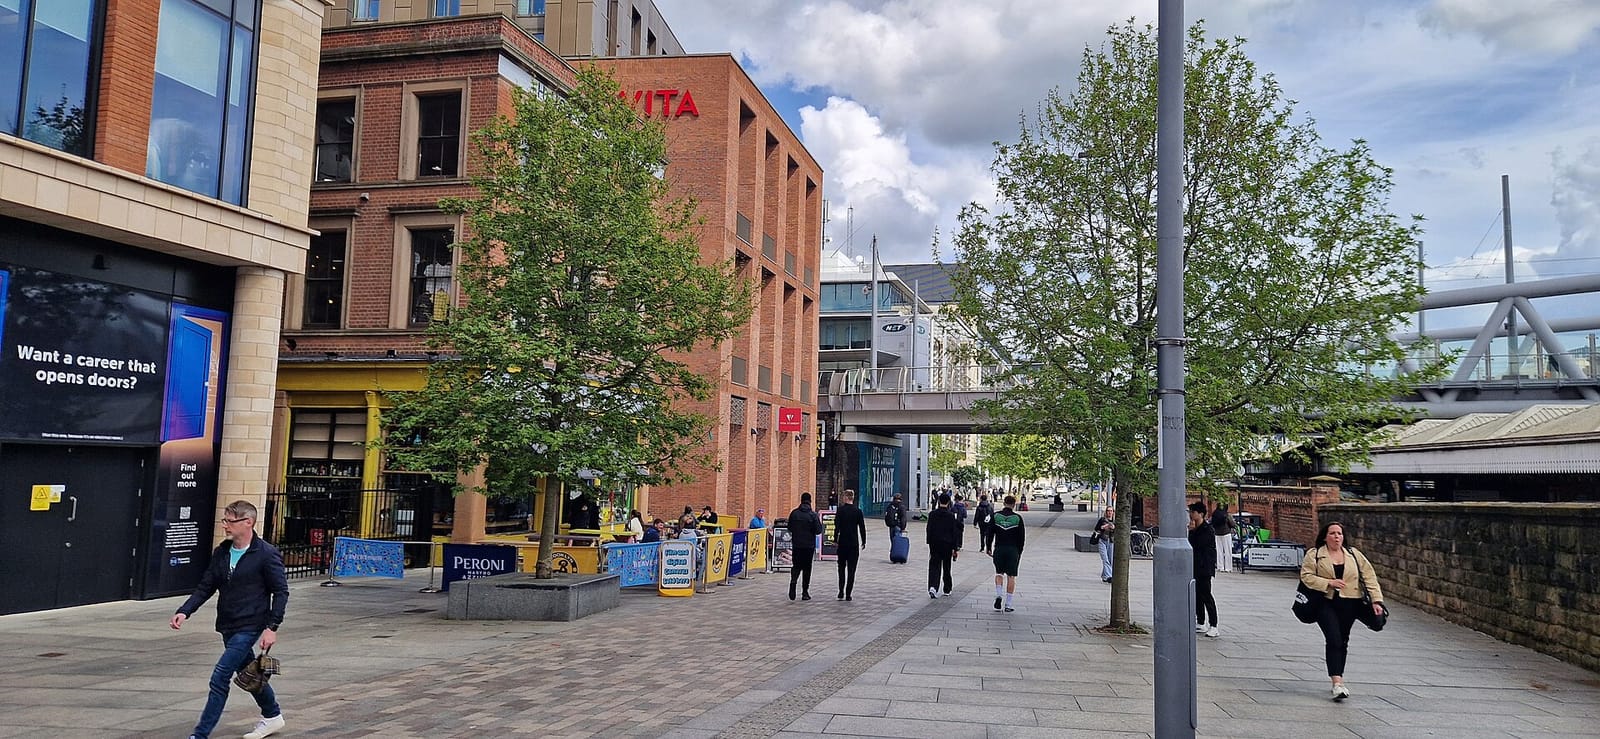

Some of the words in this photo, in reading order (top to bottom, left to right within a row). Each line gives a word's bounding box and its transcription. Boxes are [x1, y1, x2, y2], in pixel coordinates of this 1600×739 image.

[17, 344, 60, 364] Want
[63, 354, 73, 365] a
[77, 355, 124, 370] career
[127, 359, 157, 374] that
[35, 369, 84, 386] opens
[87, 373, 138, 389] doors?
[180, 464, 197, 472] Find
[177, 480, 197, 488] more
[454, 556, 505, 571] PERONI
[552, 552, 574, 564] OOKLYN
